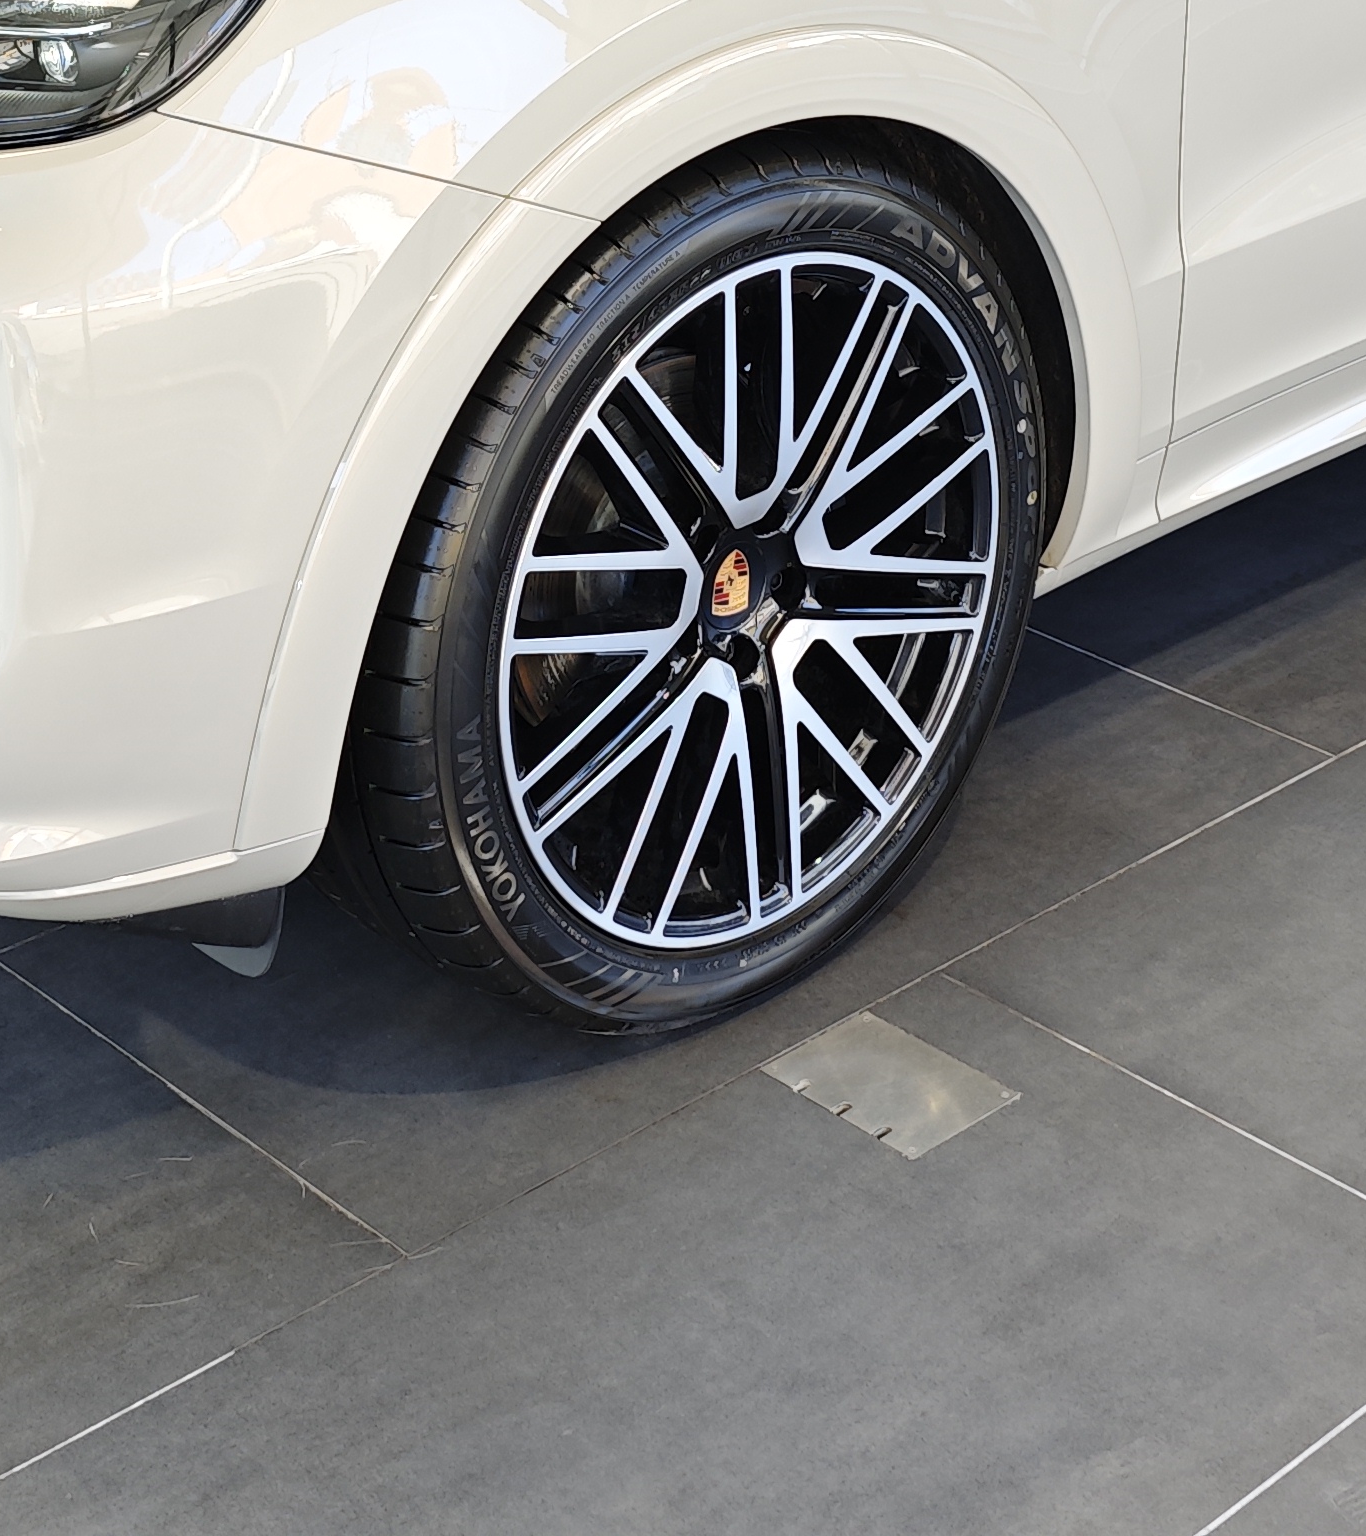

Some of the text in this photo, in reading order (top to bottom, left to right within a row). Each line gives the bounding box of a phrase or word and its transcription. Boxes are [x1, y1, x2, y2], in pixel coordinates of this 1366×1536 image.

[550, 348, 584, 395] TREADWEAR
[596, 299, 626, 331] TRACTION
[632, 255, 675, 292] TEMPERATURE
[889, 213, 1023, 376] ADVAN
[456, 714, 526, 923] YOKOHAMA
